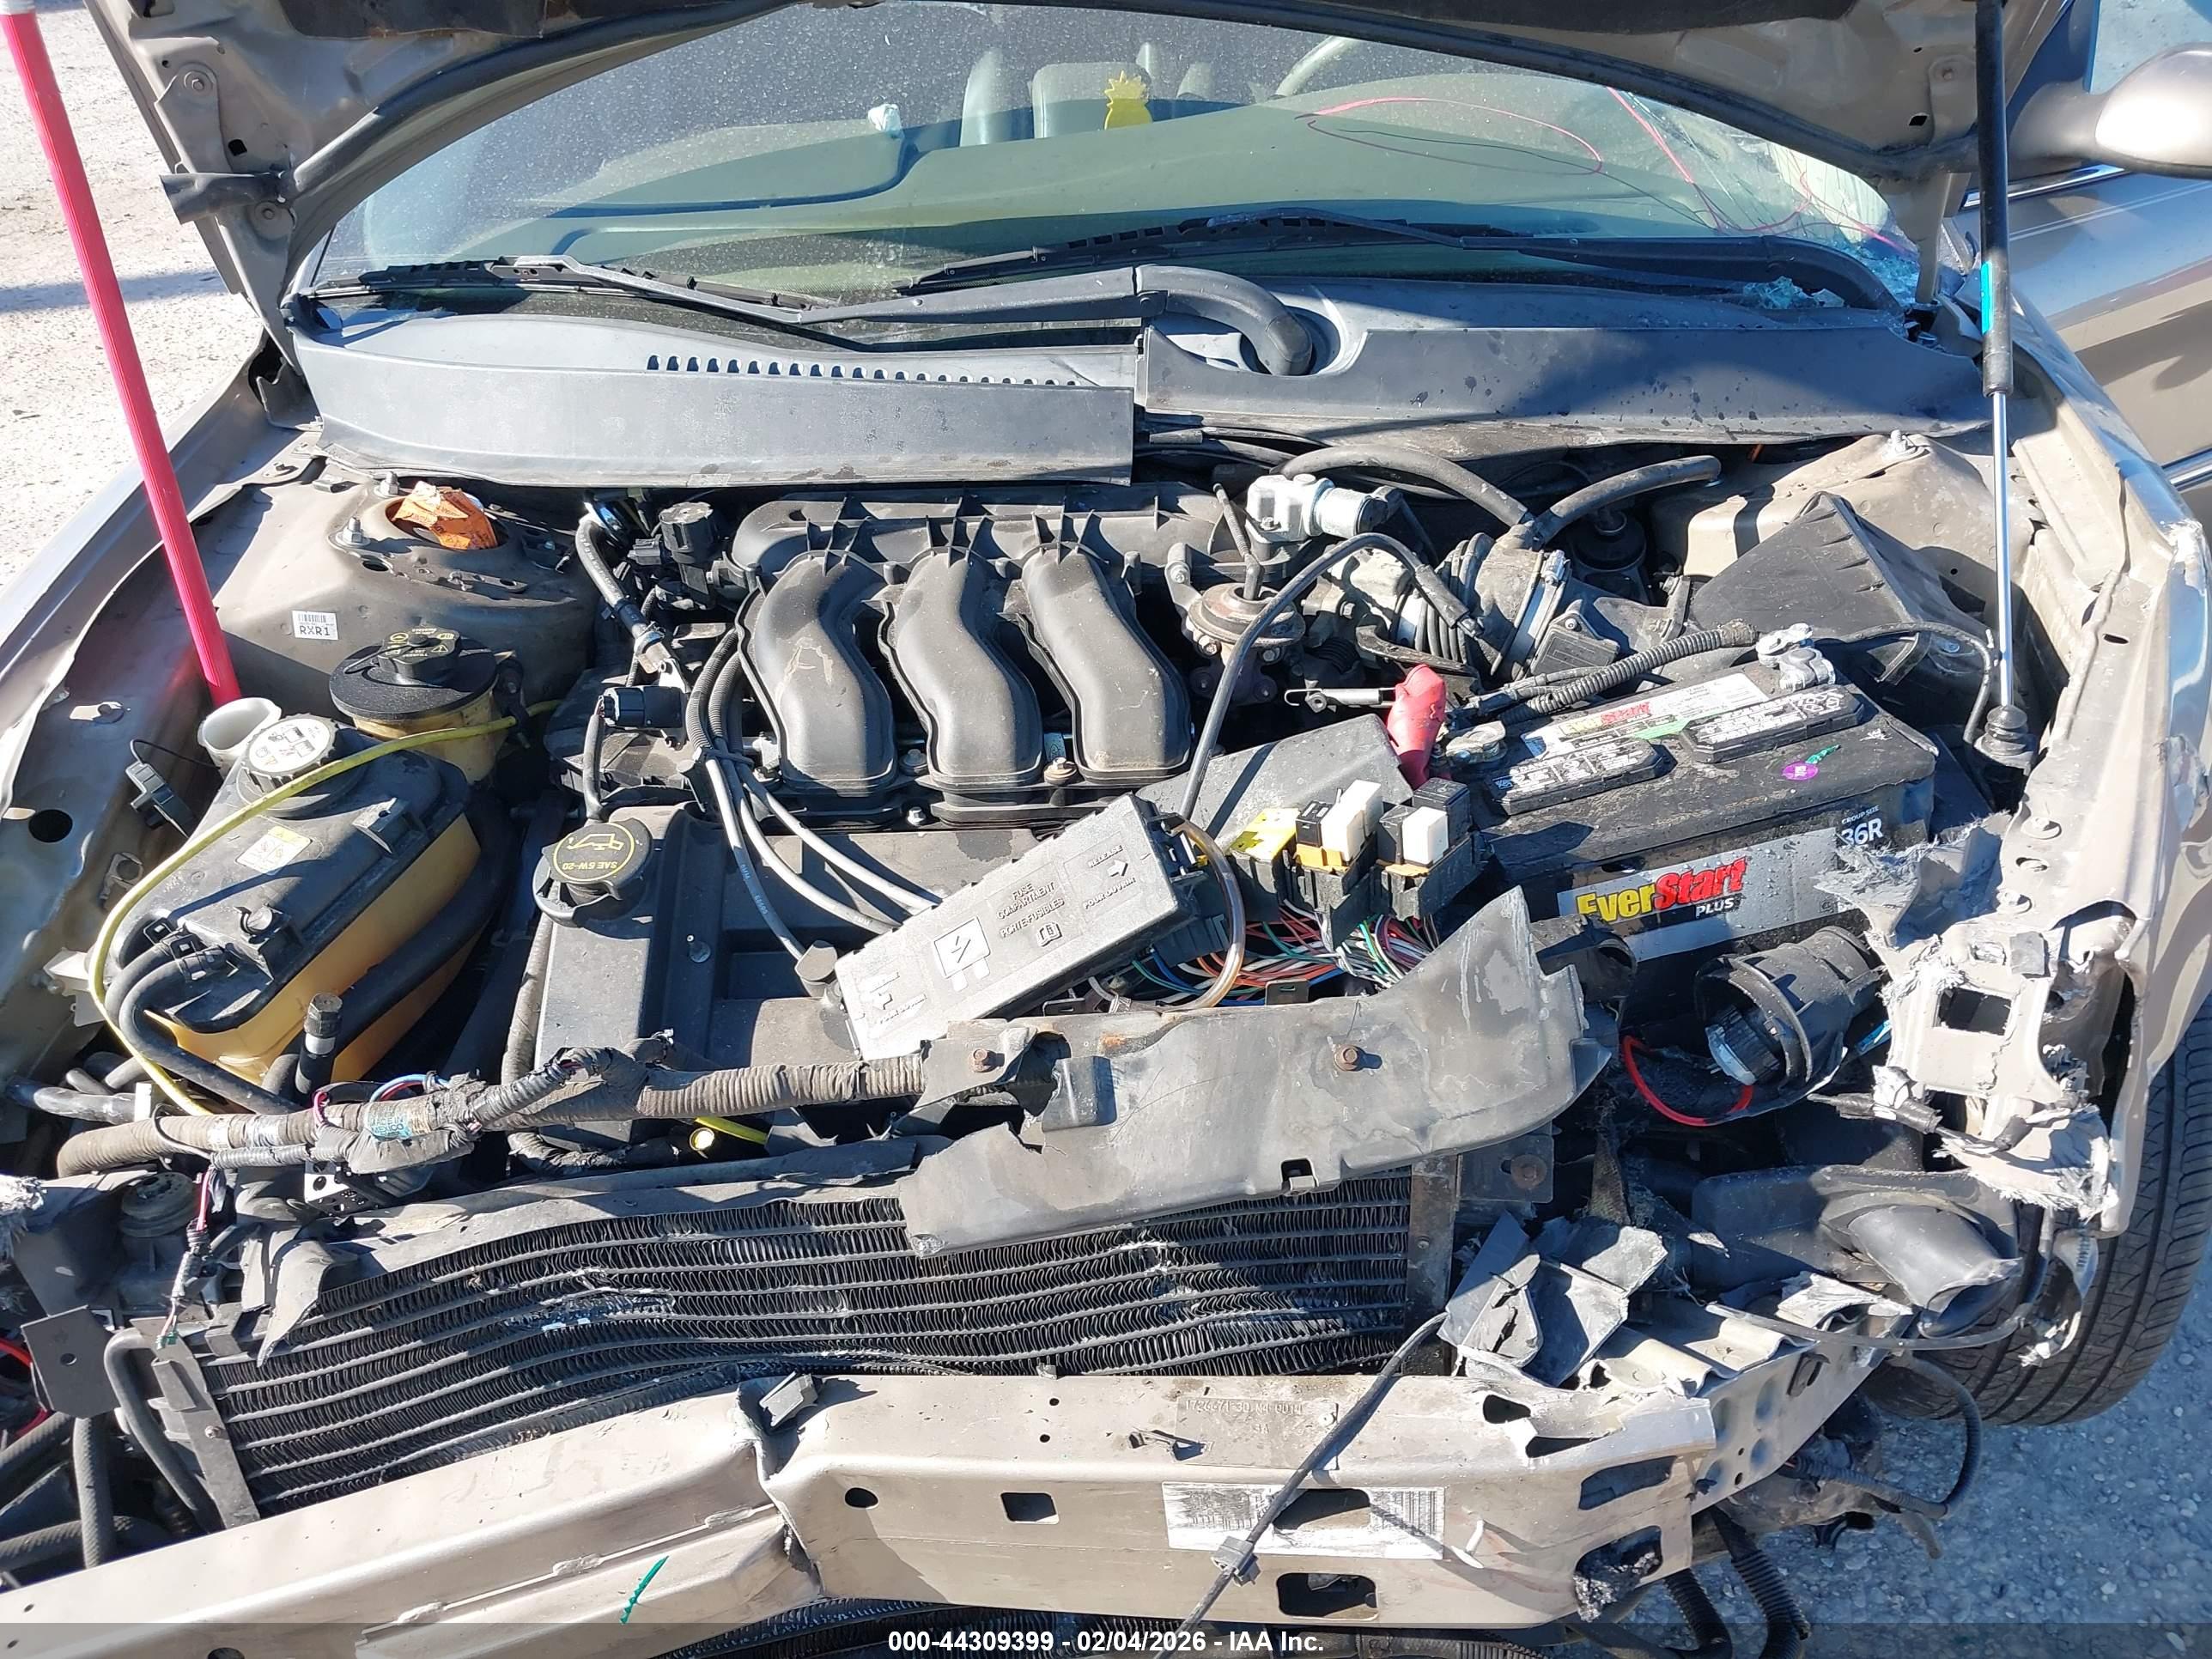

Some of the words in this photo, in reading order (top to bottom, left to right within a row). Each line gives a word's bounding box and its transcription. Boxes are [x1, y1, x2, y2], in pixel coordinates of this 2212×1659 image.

[300, 625, 330, 635] RXR1
[1841, 817, 1884, 845] 36R
[562, 861, 596, 871] 5W-20
[1087, 845, 1124, 868] RELEASE
[1012, 883, 1034, 901] FUSE
[1576, 856, 1747, 923] EverStart
[997, 882, 1055, 920] COMPARTMENT
[1083, 893, 1106, 910] POUR
[1696, 897, 1735, 918] PLUS
